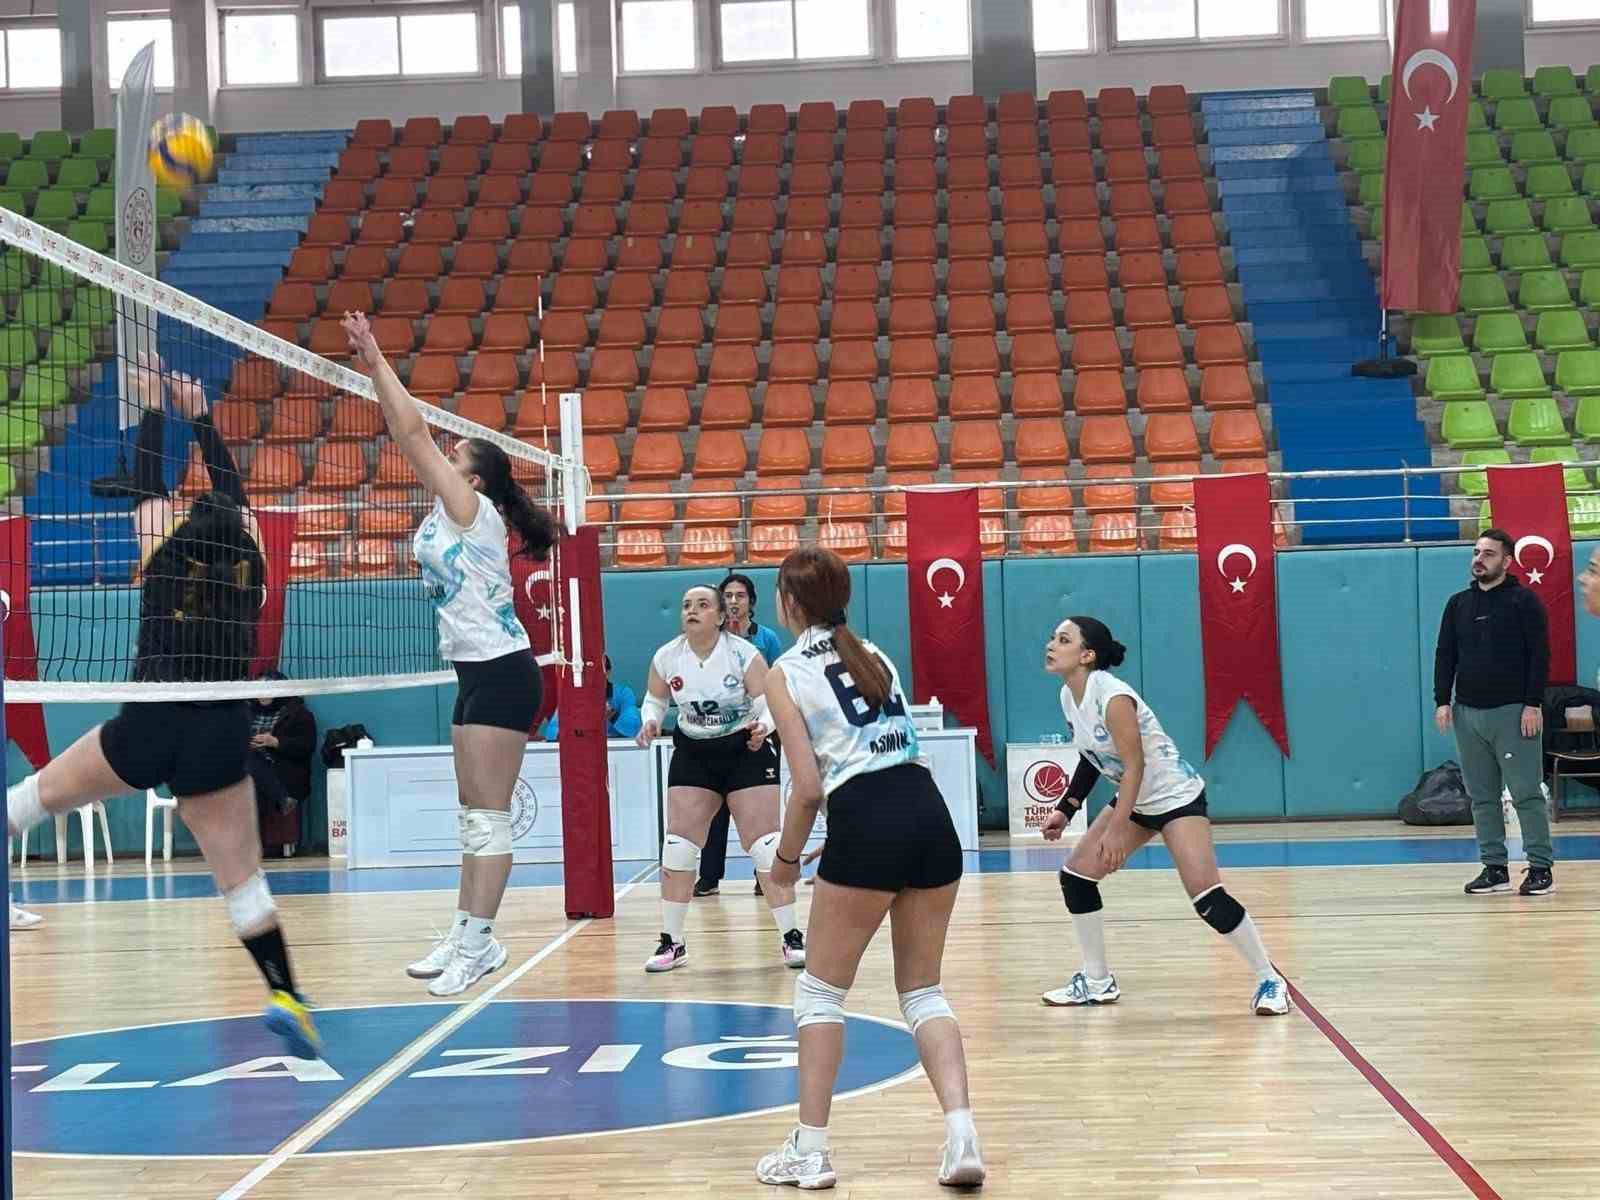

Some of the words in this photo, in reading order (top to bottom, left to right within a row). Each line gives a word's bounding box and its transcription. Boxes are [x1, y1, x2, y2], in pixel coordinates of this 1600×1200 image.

[690, 700, 720, 715] 12
[1024, 804, 1053, 815] TÜRK
[332, 827, 347, 838] BA
